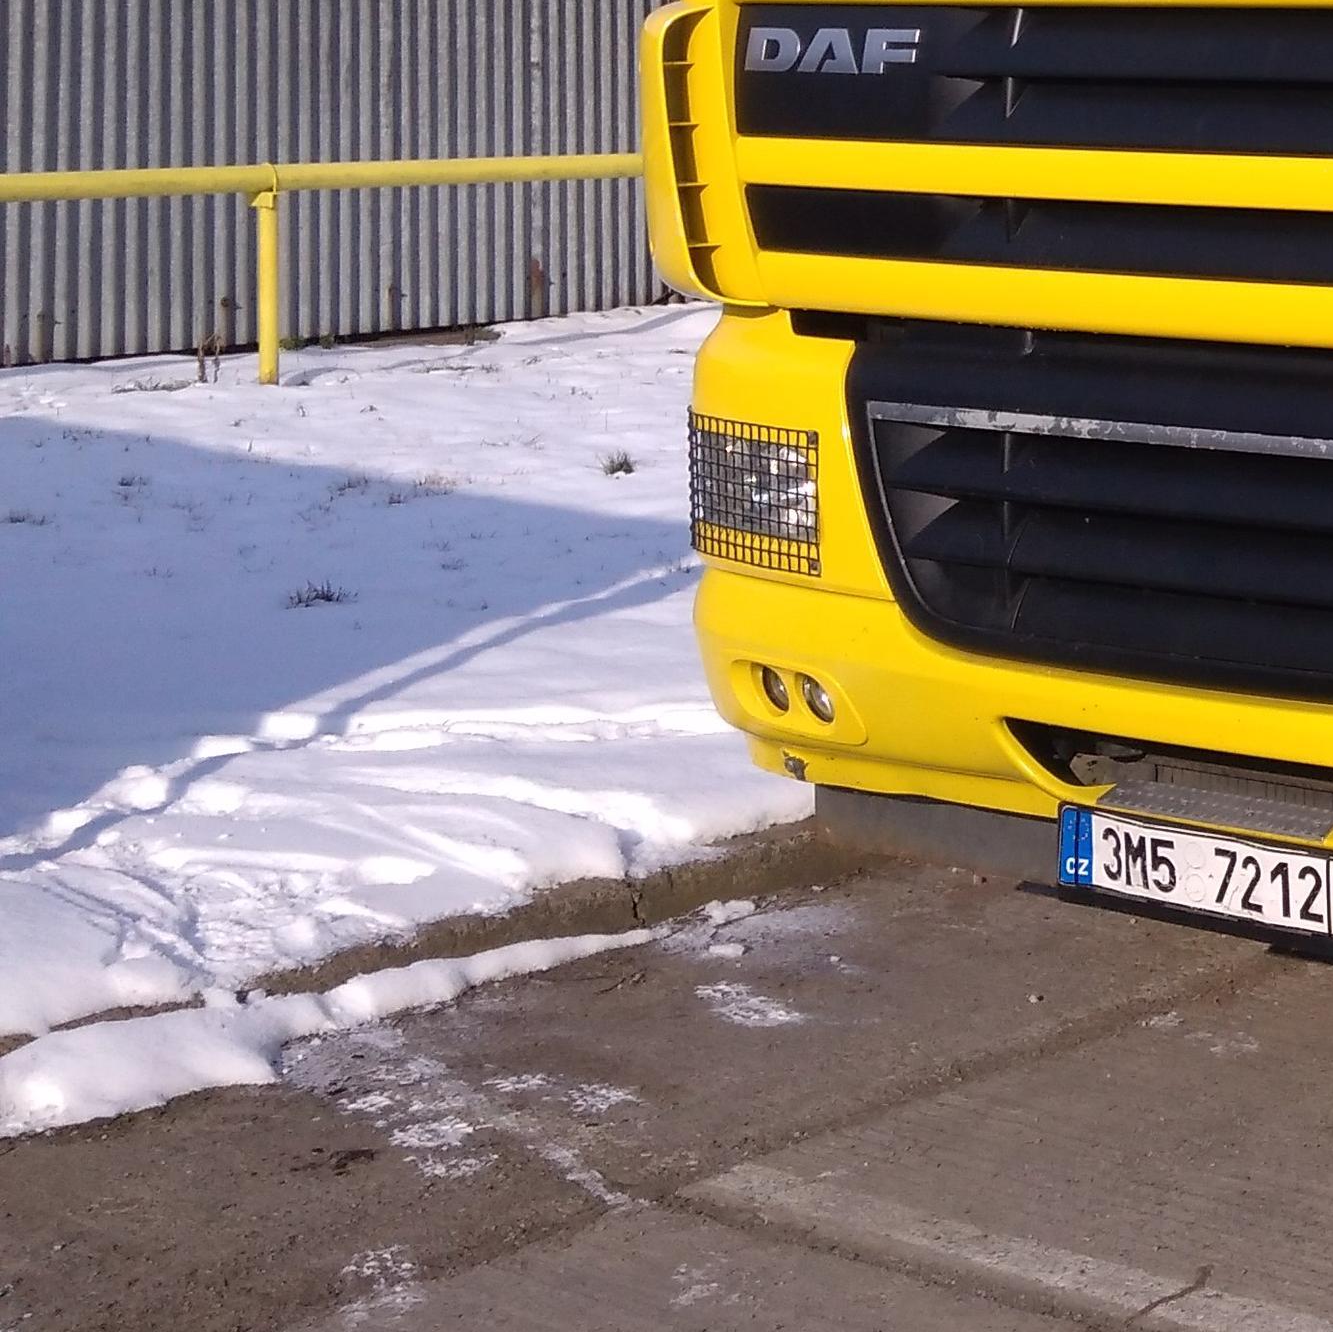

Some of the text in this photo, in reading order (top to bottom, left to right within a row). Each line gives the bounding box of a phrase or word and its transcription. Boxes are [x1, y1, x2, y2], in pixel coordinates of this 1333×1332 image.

[744, 26, 921, 75] DAF
[1066, 857, 1089, 876] CZ
[1102, 827, 1325, 923] 3M5 7212
